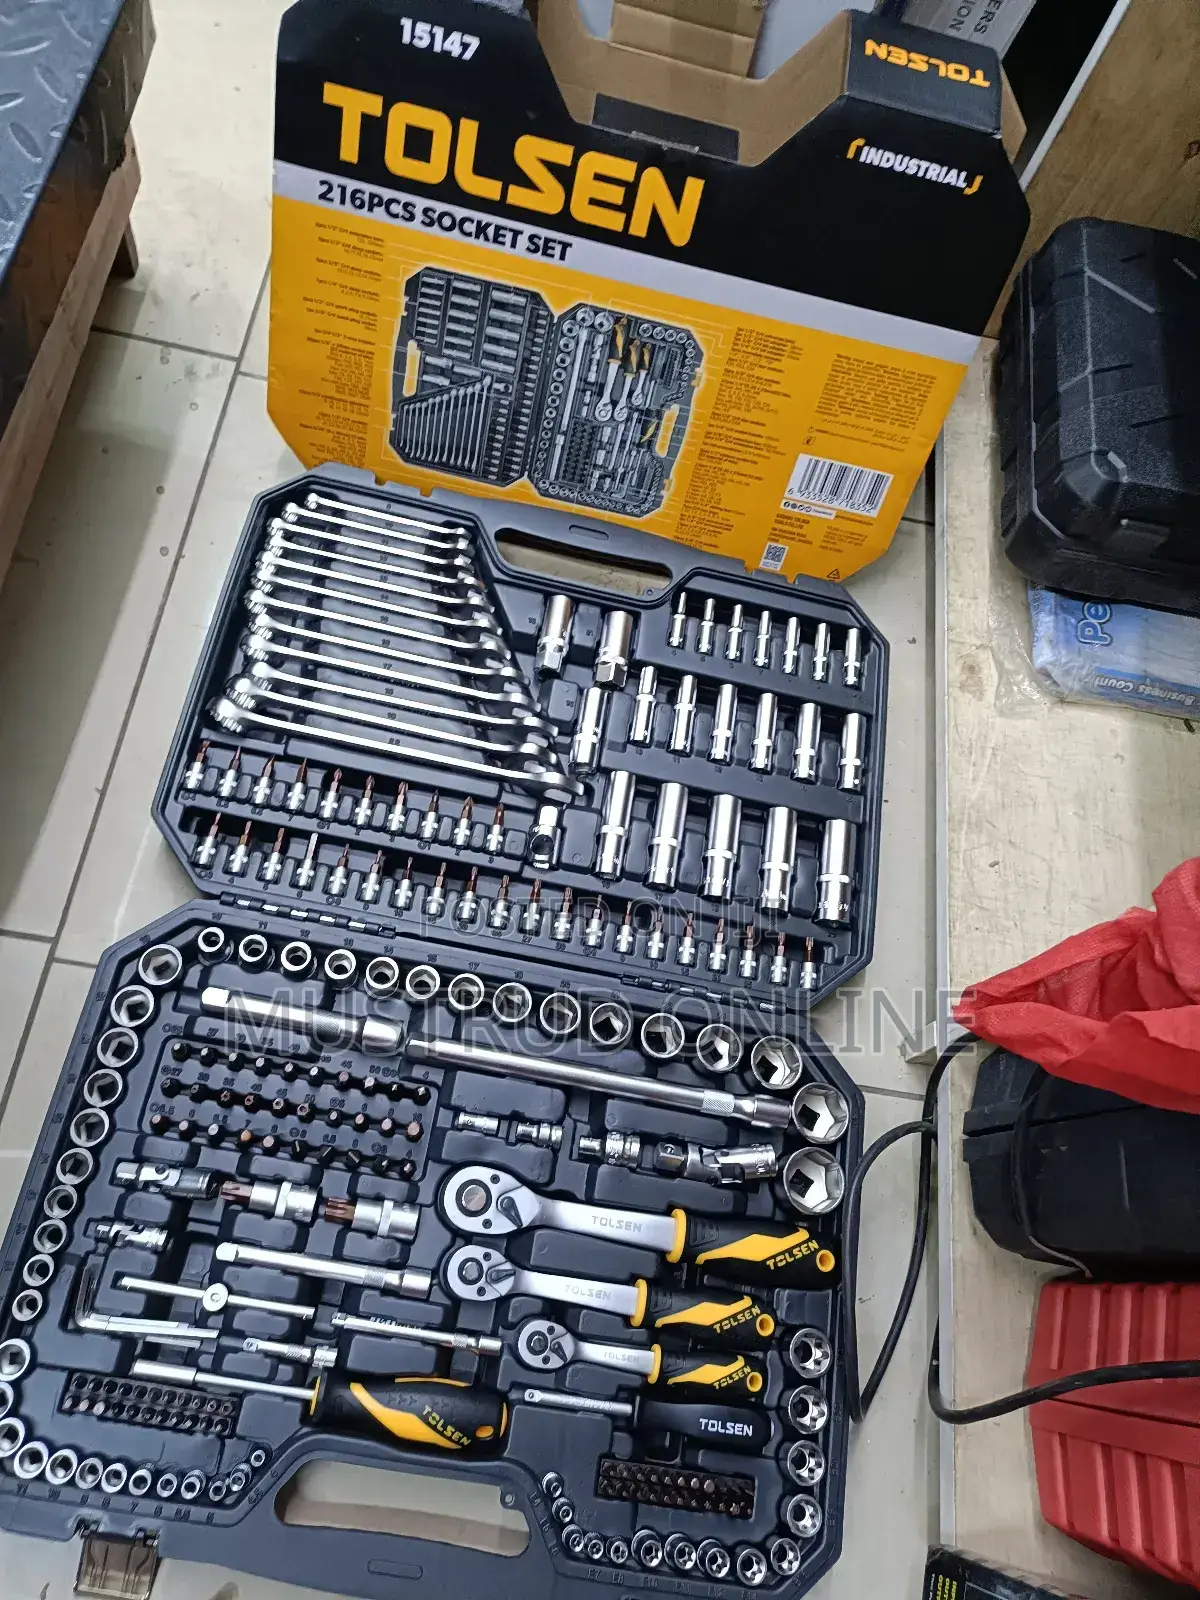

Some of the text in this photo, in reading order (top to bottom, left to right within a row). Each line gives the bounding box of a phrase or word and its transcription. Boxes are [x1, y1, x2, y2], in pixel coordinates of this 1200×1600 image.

[400, 17, 480, 61] 15147
[864, 38, 991, 88] TOLSEN
[322, 81, 705, 248] TOLSEN
[860, 145, 968, 190] INDUSTRIAL
[317, 179, 416, 223] 216PCS
[420, 206, 522, 254] SOCKET
[525, 233, 573, 263] SET
[1138, 683, 1196, 706] Business
[591, 1214, 642, 1233] TOLSEN
[766, 1239, 820, 1271] TOLSEN
[565, 1283, 612, 1301] TOLSEN
[713, 1304, 760, 1334] TOLSEN
[603, 1350, 640, 1363] TOLSEN
[713, 1365, 752, 1390] TOLSEN
[423, 1404, 472, 1446] TOLSEN
[699, 1416, 754, 1438] TOLSEN
